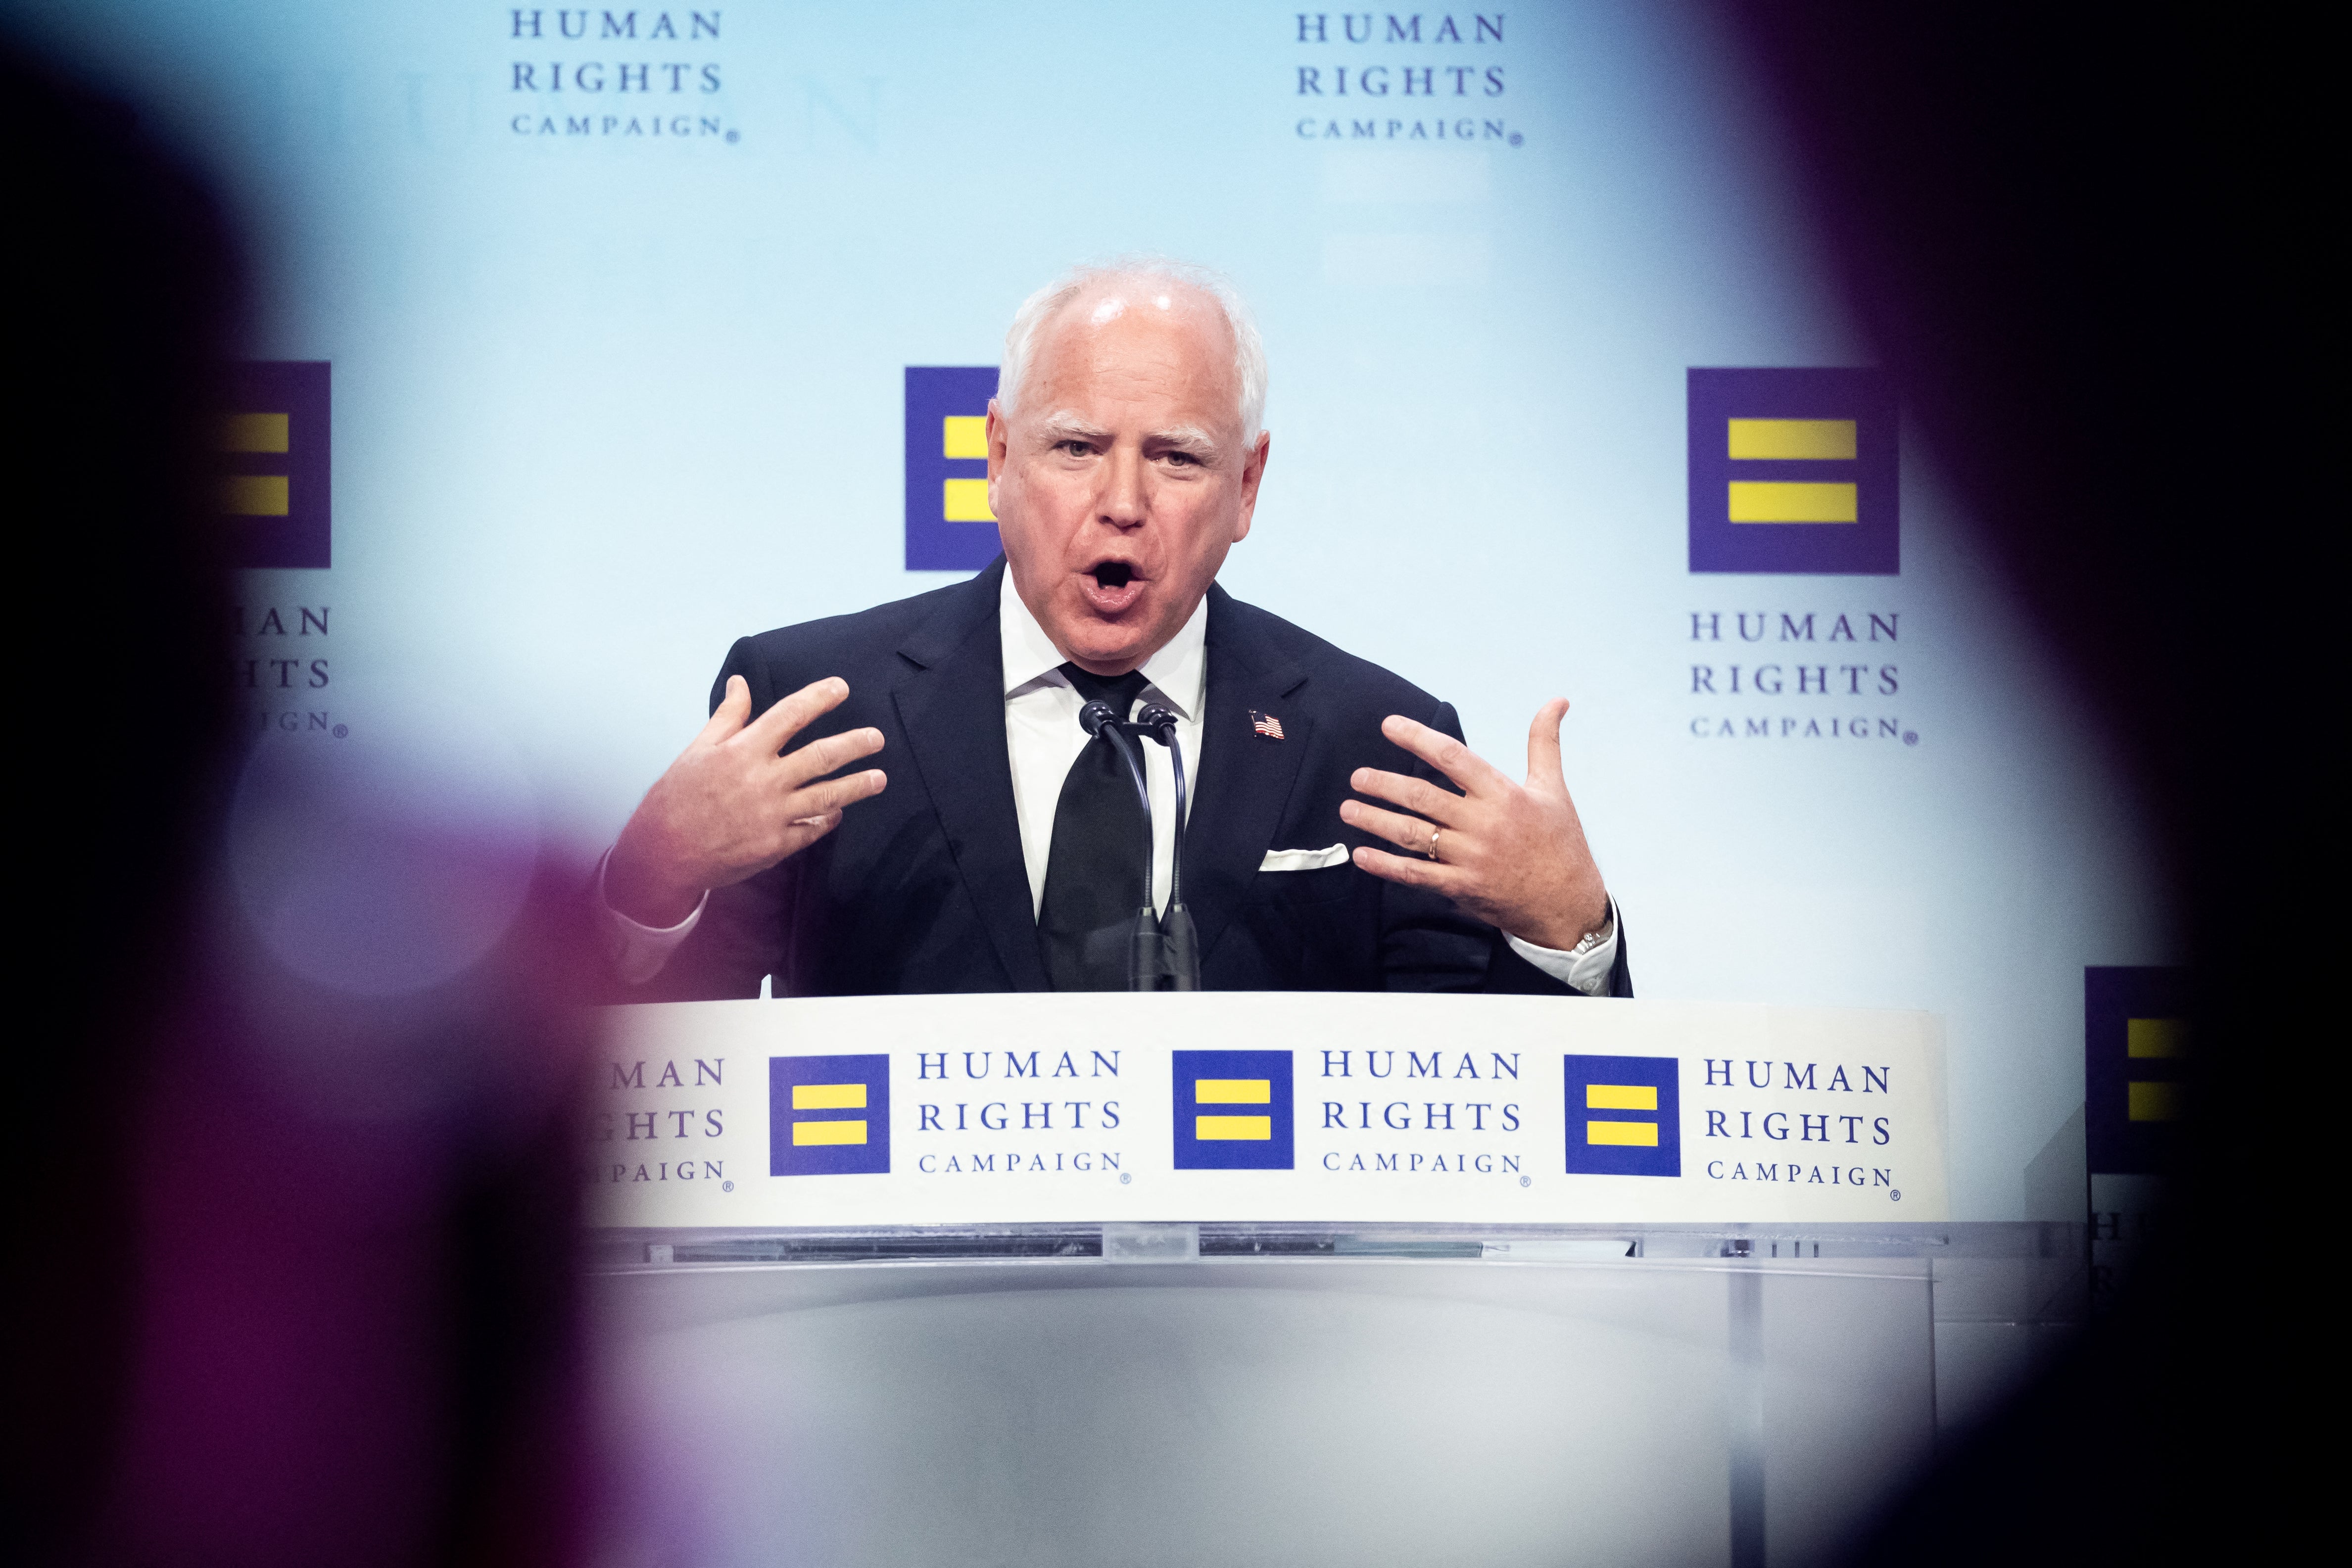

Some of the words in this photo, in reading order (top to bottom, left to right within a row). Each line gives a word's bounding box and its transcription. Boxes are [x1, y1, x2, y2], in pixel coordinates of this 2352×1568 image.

[511, 9, 721, 40] HUMAN
[1296, 13, 1505, 44] HUMAN
[512, 61, 721, 94] RIGHTS
[1296, 65, 1505, 97] RIGHTS
[1690, 612, 1900, 642] HUMAN
[1691, 665, 1899, 695] RIGHTS
[610, 1058, 724, 1090] MAN
[917, 1050, 1122, 1080] HUMAN
[1320, 1050, 1521, 1080] HUMAN
[1704, 1058, 1890, 1094] HUMAN
[590, 1108, 724, 1143] GHTS
[918, 1101, 1120, 1131] RIGHTS
[1322, 1101, 1520, 1132] RIGHTS
[1705, 1109, 1890, 1145] RIGHTS
